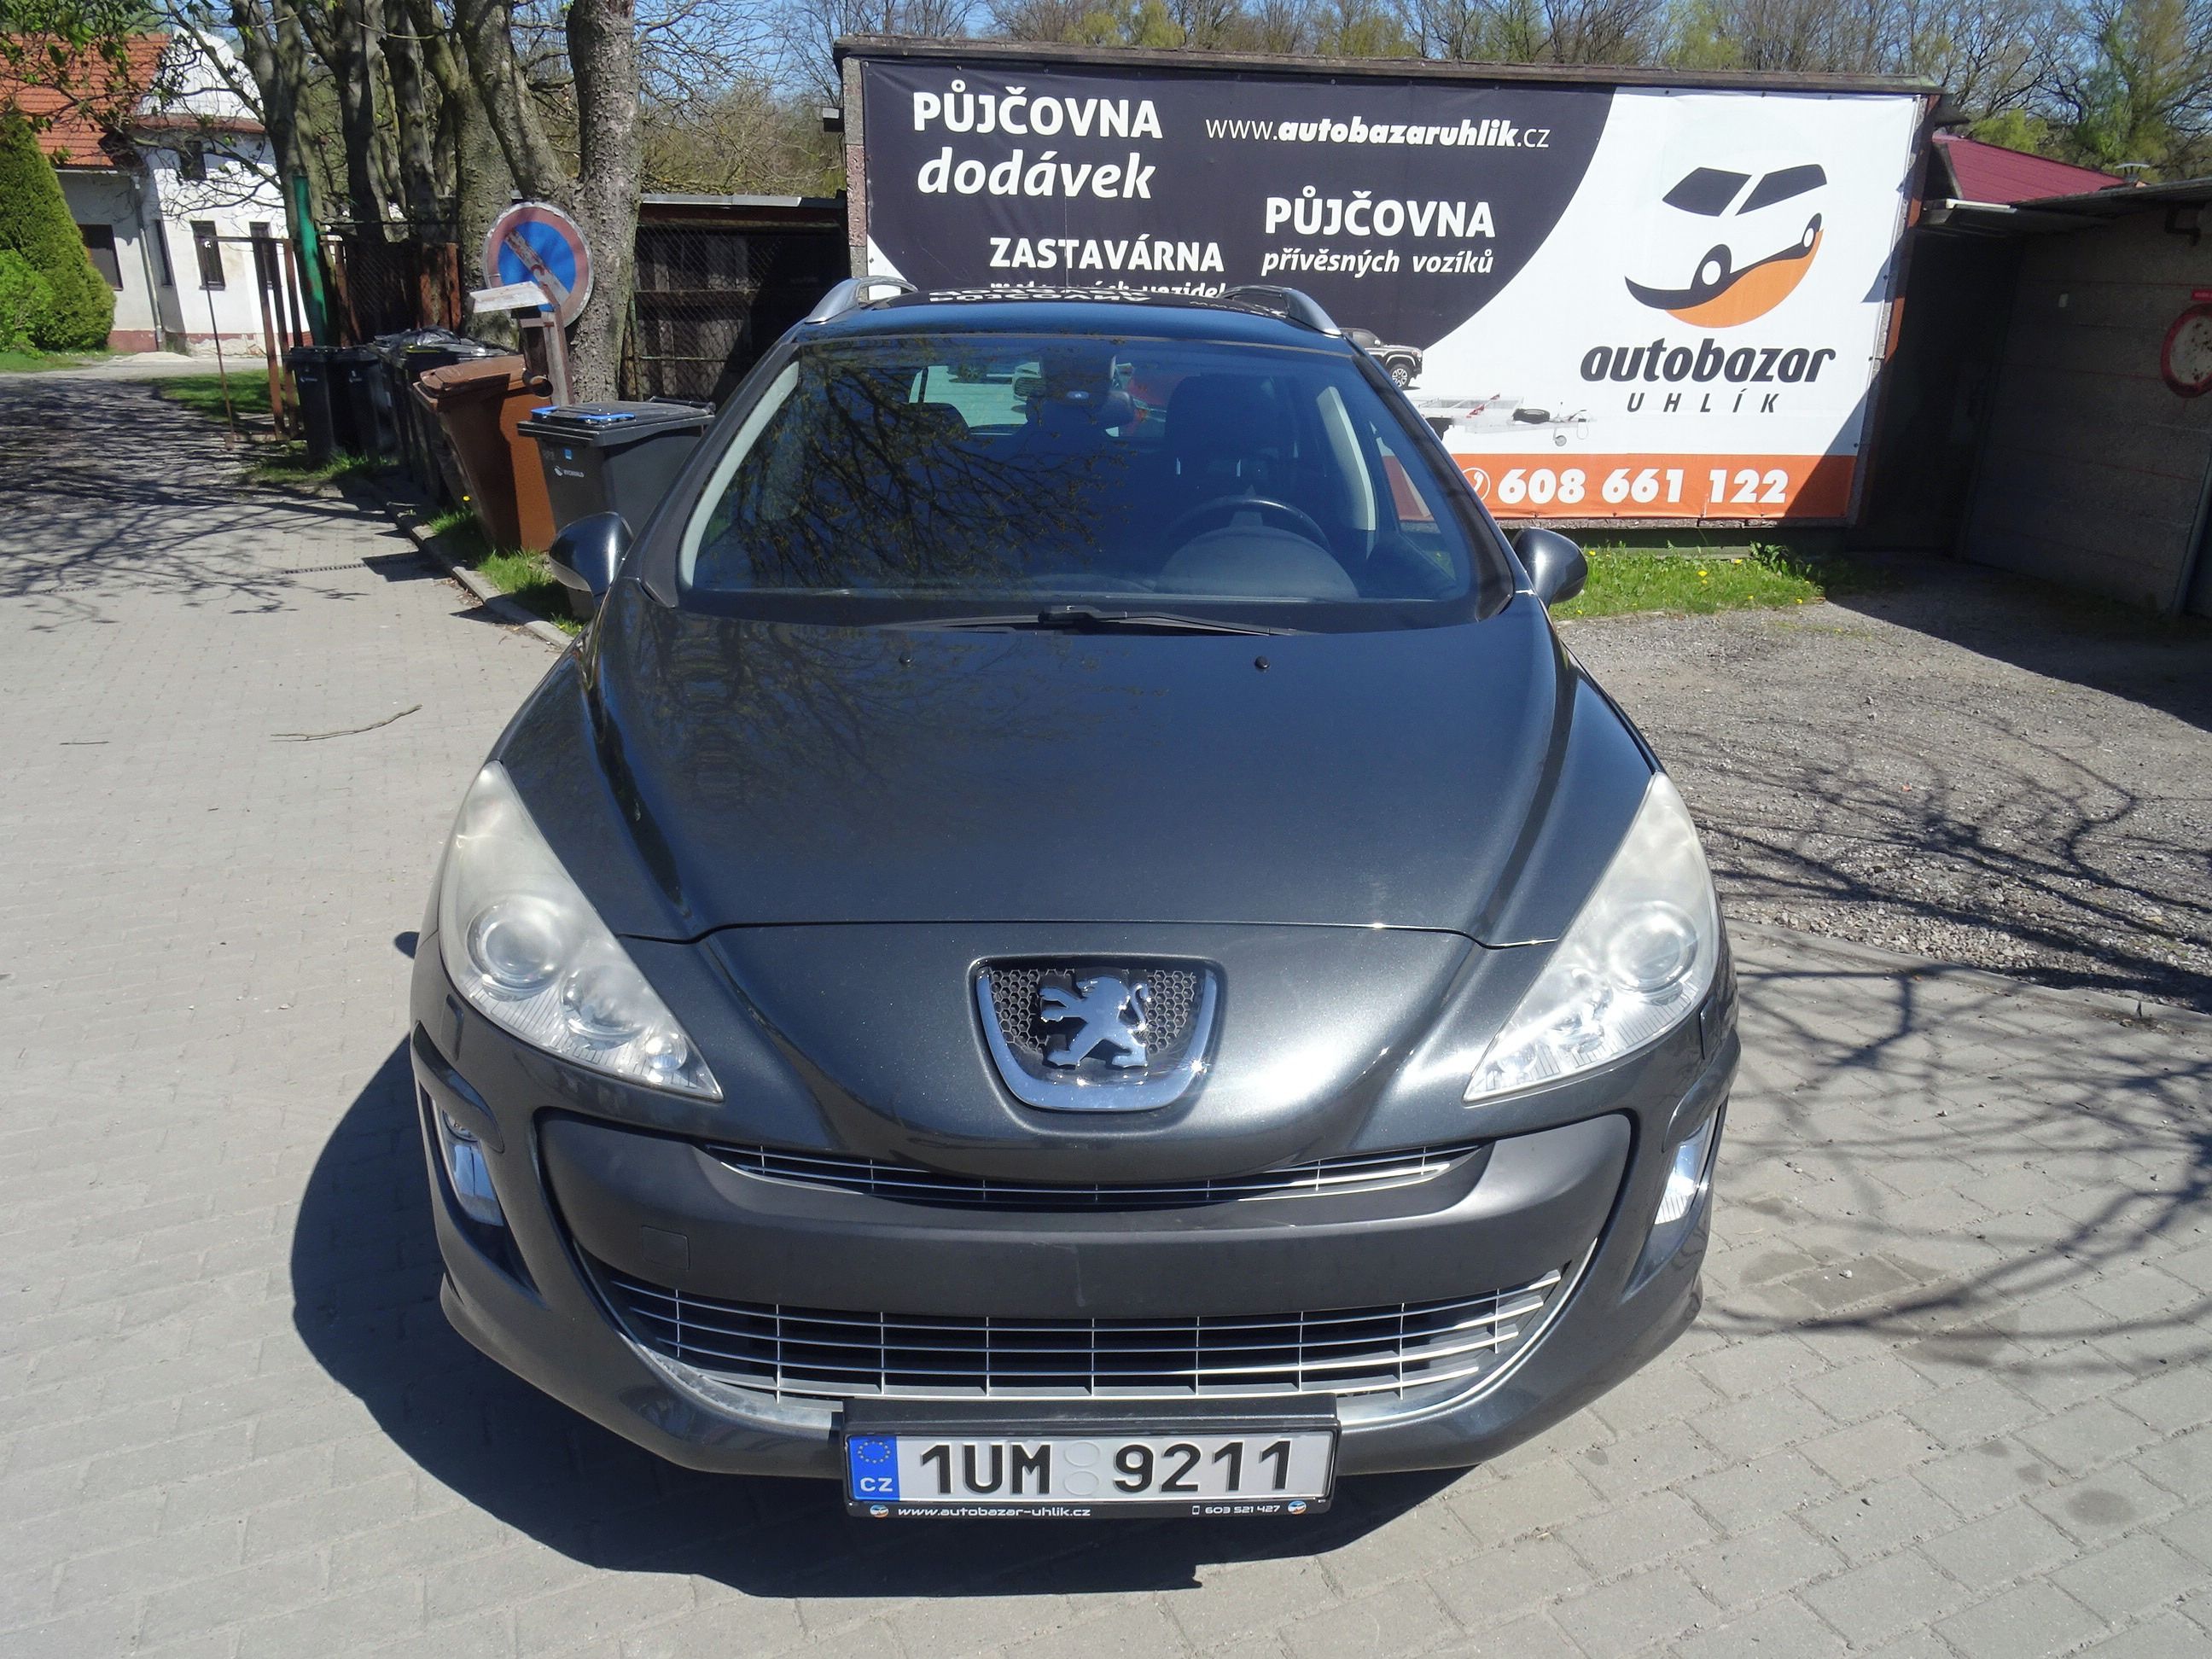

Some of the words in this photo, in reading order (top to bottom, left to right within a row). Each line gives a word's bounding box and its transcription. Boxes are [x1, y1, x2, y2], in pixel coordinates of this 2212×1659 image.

[913, 79, 1163, 139] PŮJČOVNA
[1205, 116, 1551, 148] www.autobazaruhlik.cz
[917, 146, 1156, 199] dodávek
[1265, 184, 1496, 238] PŮJČOVNA
[989, 233, 1225, 272] ZASTAVÁRNA
[1260, 247, 1400, 278] přívěsných
[1412, 248, 1494, 273] vozíků
[1580, 337, 1837, 383] autobazar
[1627, 387, 1779, 413] UHLÍK
[1497, 469, 1586, 504] 608
[1601, 469, 1685, 504] 661
[1707, 469, 1789, 504] 122
[859, 1477, 894, 1492] CZ
[922, 1445, 1051, 1494] 1UM
[1114, 1441, 1290, 1493] 9211
[898, 1506, 1091, 1516] www.autobazar-uhlik.cz
[1233, 1505, 1254, 1514] 521
[1256, 1505, 1281, 1513] 427
